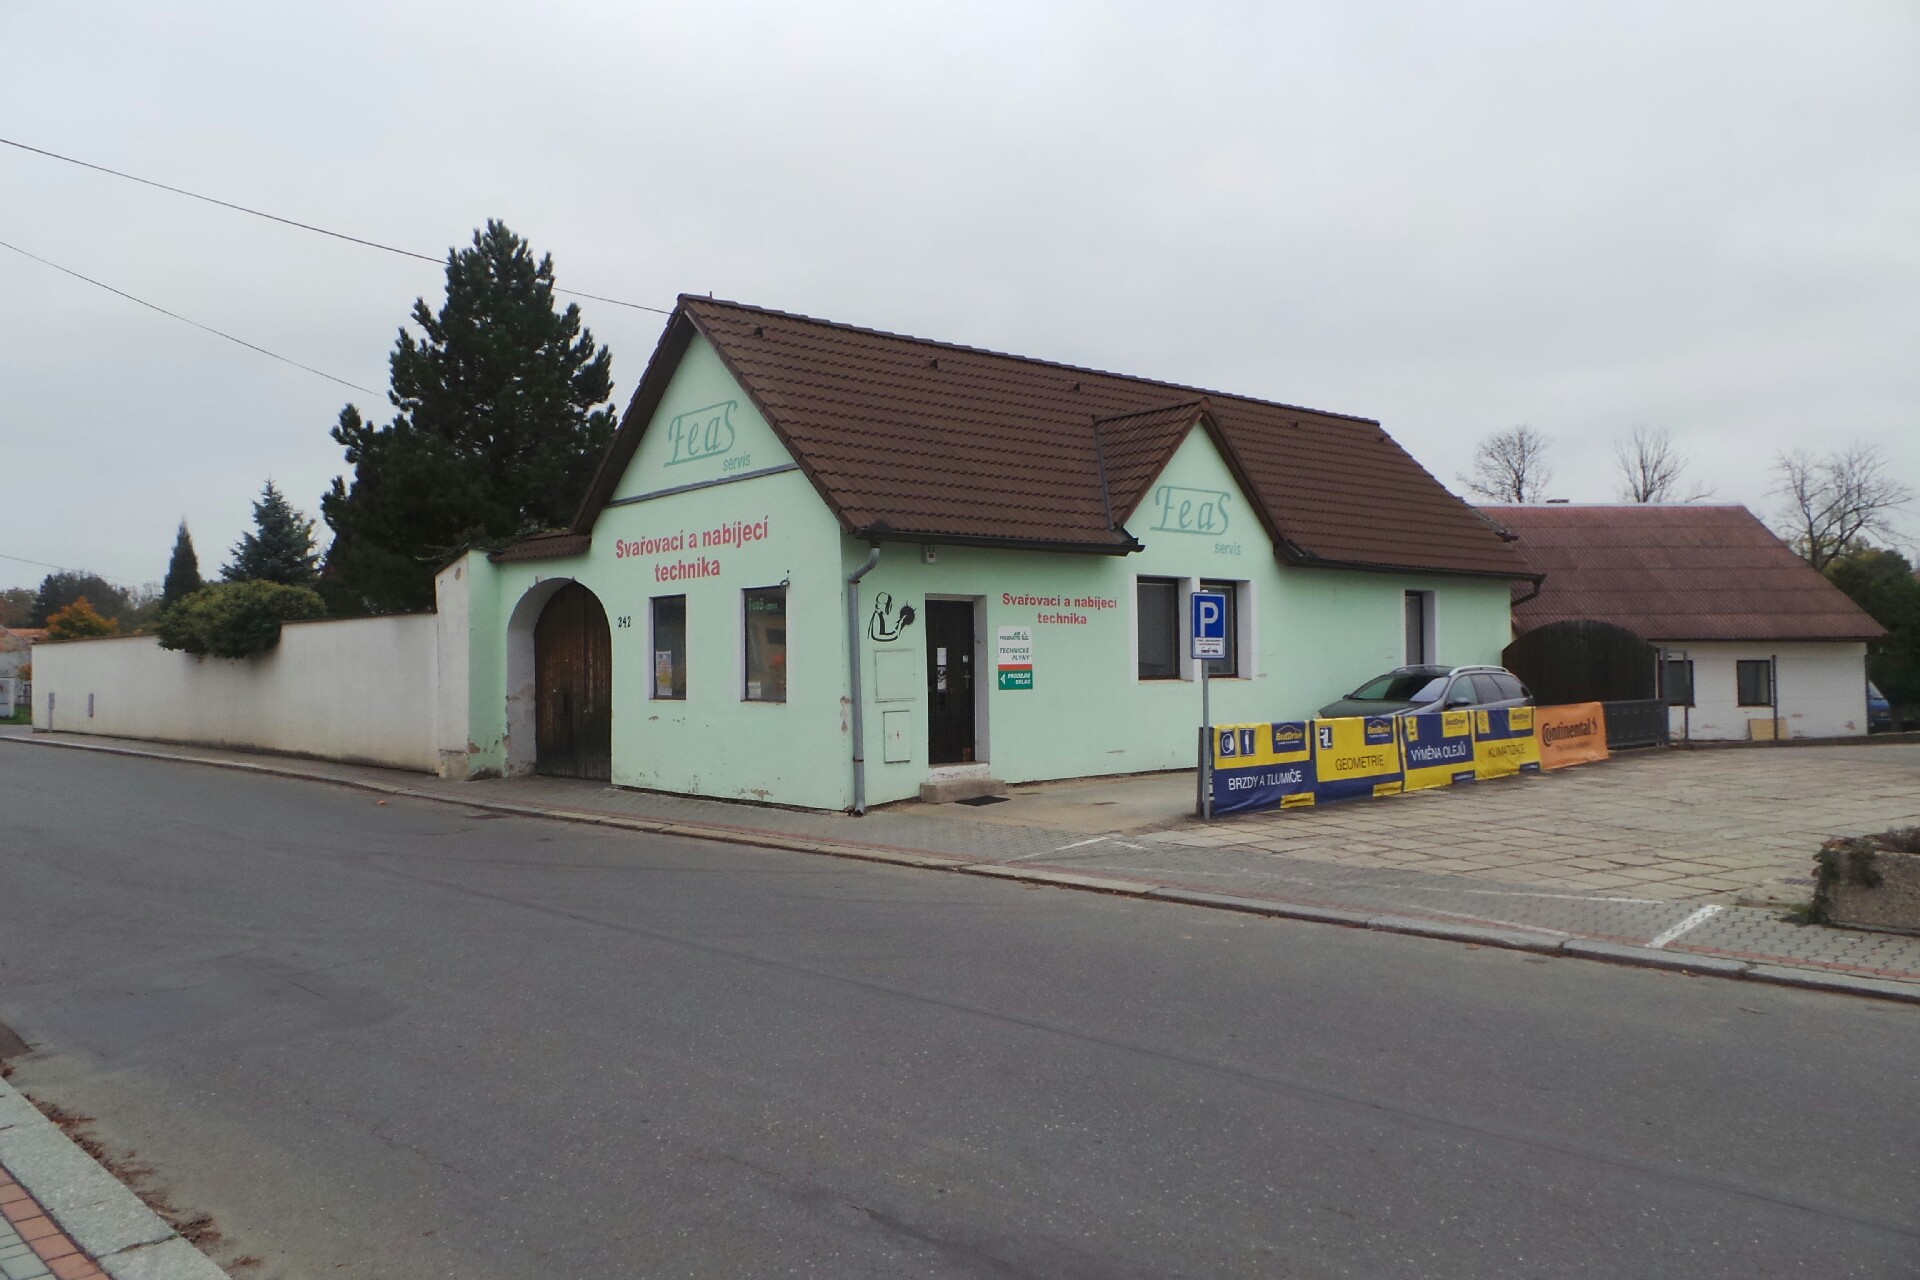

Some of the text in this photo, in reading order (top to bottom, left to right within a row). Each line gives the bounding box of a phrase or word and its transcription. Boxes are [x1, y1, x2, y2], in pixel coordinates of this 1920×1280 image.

[723, 451, 750, 472] servis
[616, 515, 768, 558] Svařovací a nabíjecí
[1214, 541, 1242, 555] servis
[655, 556, 720, 582] technika
[1064, 597, 1071, 607] a
[617, 615, 632, 628] 242
[1037, 612, 1087, 625] technika
[1199, 601, 1219, 638] P
[1541, 717, 1591, 747] Continental
[1410, 740, 1467, 762] VÝMĚNA OLEJŮ
[1335, 754, 1385, 771] GEOMETRIE
[1228, 768, 1303, 790] BRZDY A TLUMIČE
